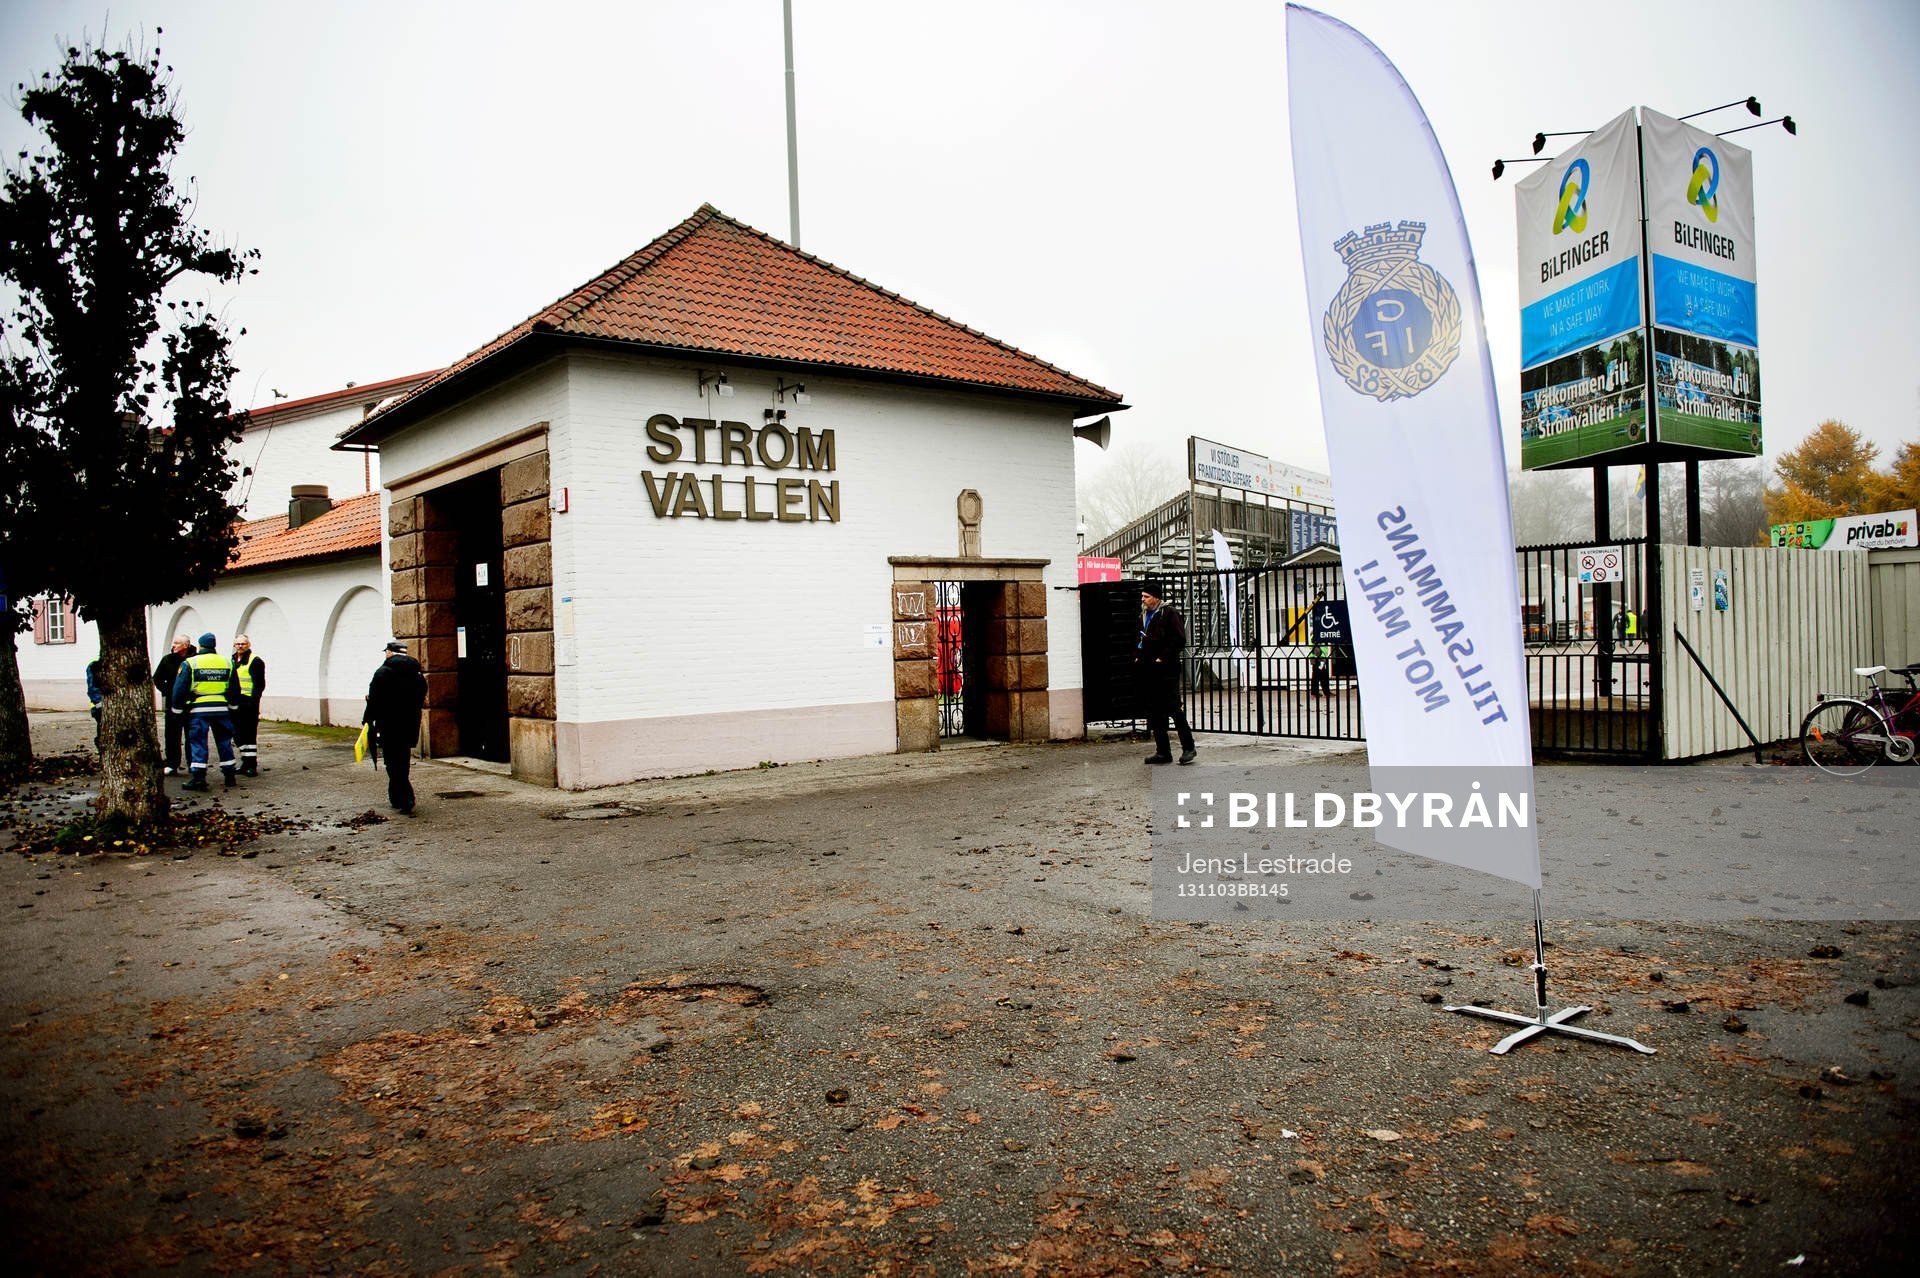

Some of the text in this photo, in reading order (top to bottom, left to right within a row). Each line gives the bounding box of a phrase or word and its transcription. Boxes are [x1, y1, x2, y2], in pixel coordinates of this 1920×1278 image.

[1543, 278, 1610, 318] WE MAKE IT WORK
[1550, 304, 1603, 337] IN A SAFE WAY
[1534, 359, 1629, 411] Välkommen till
[1670, 359, 1733, 391] Välkommen
[1538, 402, 1614, 439] Strömvallen
[1676, 393, 1741, 423] Strömvallen
[646, 409, 836, 471] STRÖM
[641, 470, 840, 522] VALLEN
[1846, 519, 1895, 545] privab
[1319, 630, 1341, 639] ENTRÉ
